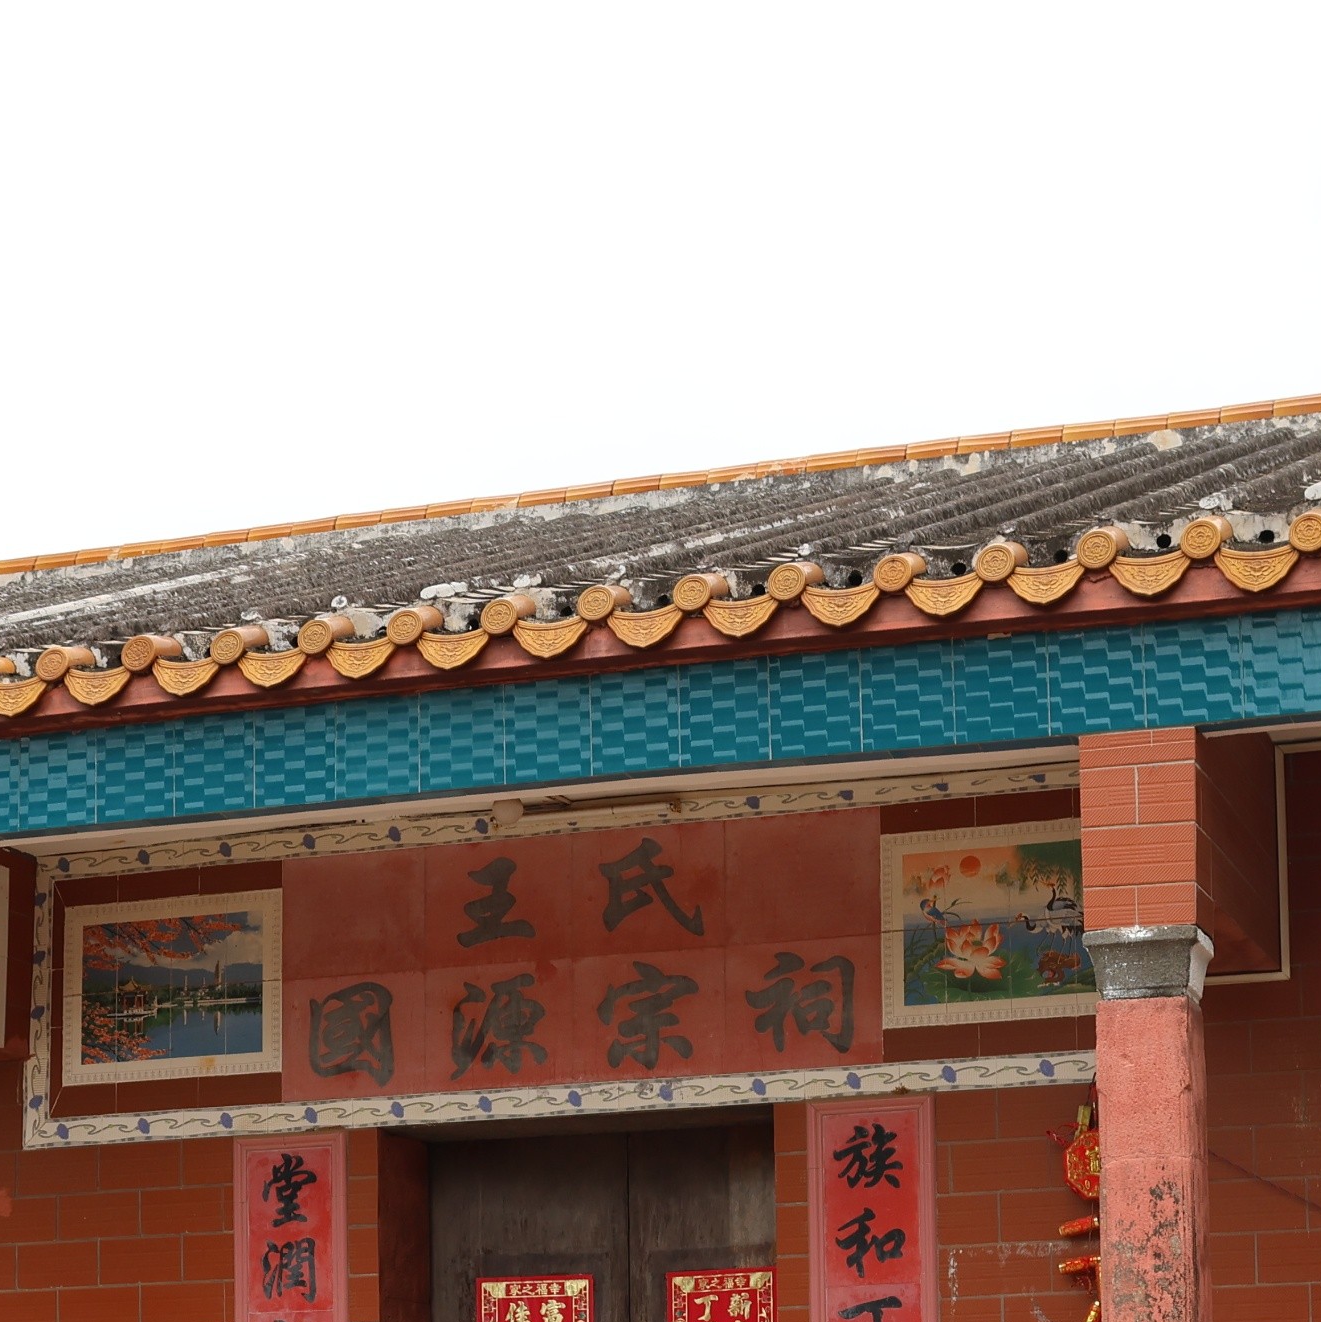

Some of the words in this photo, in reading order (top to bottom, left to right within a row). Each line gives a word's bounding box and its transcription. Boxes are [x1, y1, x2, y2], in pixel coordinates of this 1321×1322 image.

[456, 837, 704, 949] 王氏
[308, 951, 856, 1087] 國源宗祠
